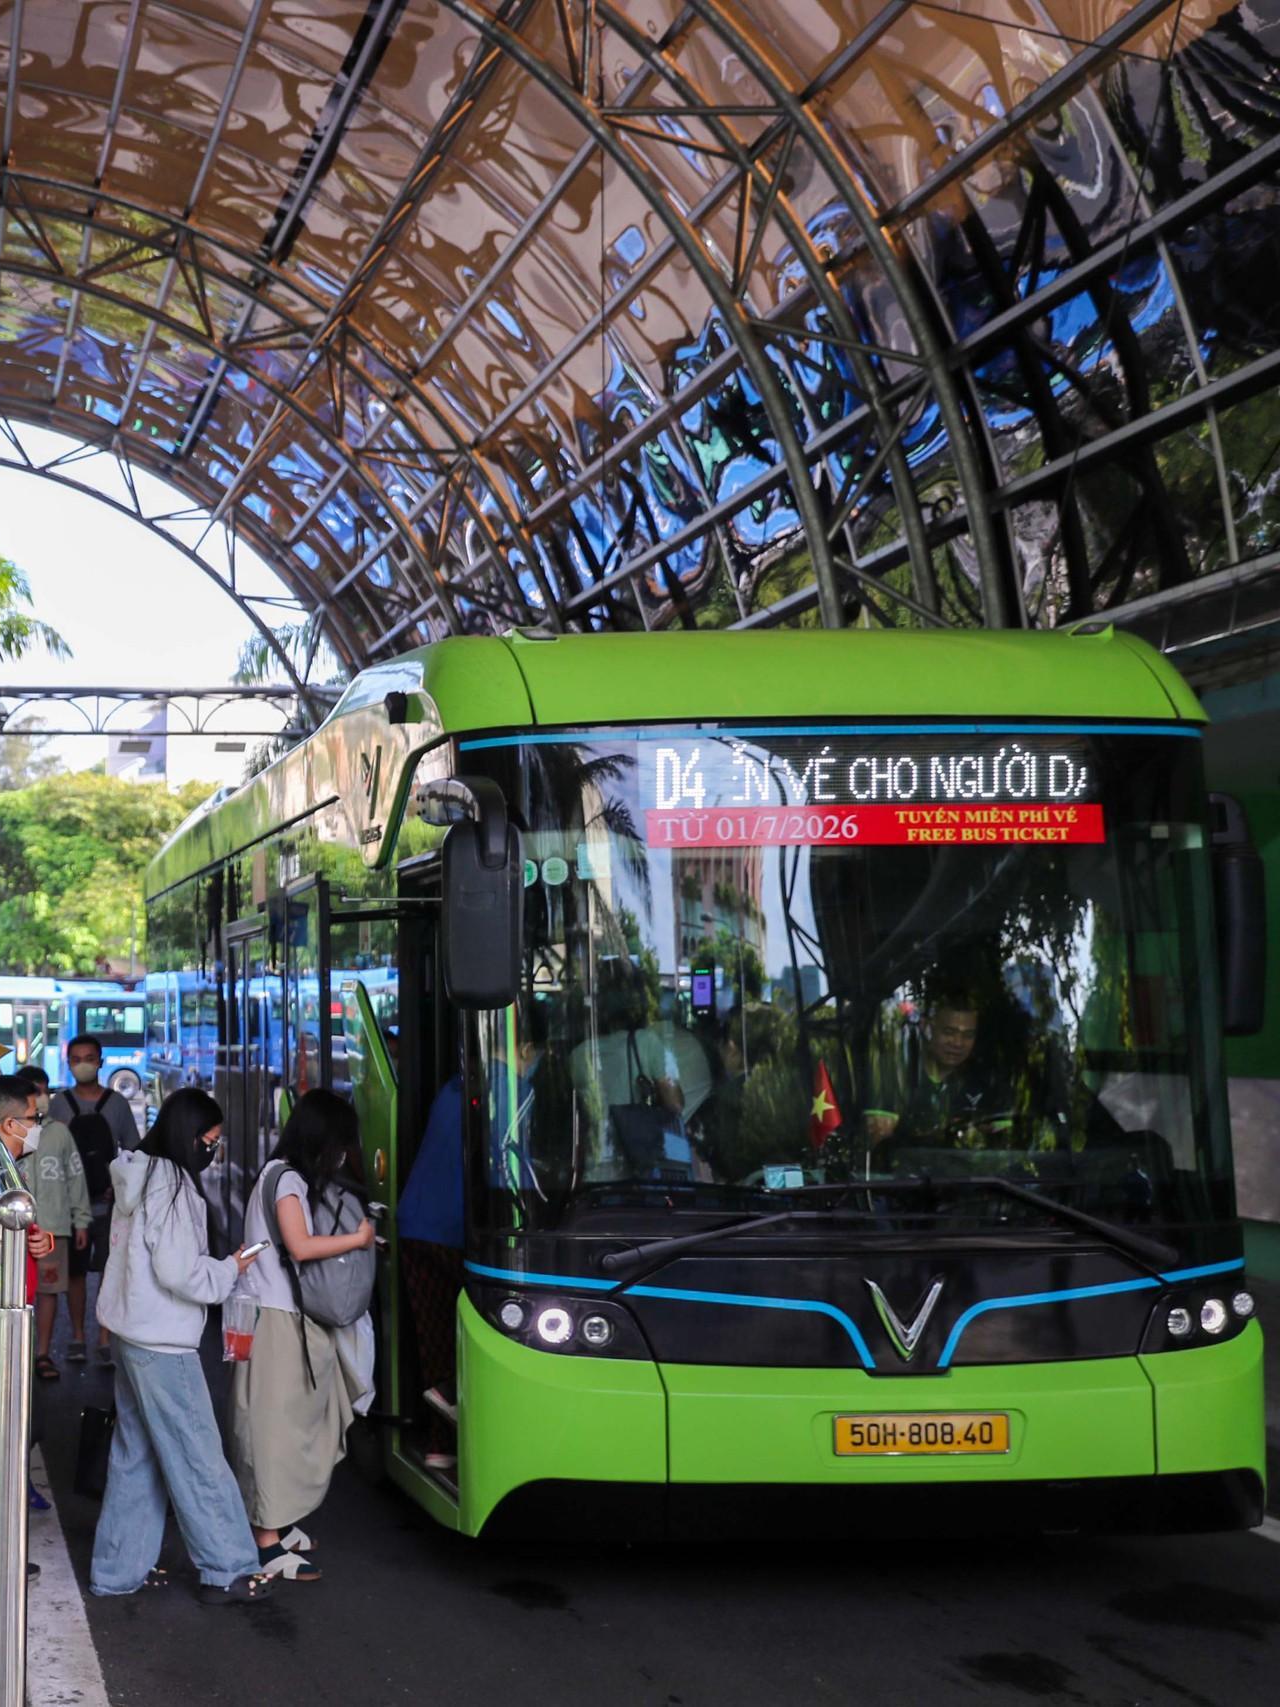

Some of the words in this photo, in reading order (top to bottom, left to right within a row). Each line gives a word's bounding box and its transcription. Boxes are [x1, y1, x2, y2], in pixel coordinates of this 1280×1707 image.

[655, 747, 706, 810] D4
[782, 745, 836, 800] VÉ
[849, 757, 918, 799] CHO
[930, 743, 1037, 799] NGƯỜI
[657, 811, 709, 842] TỪ
[716, 813, 859, 842] 01/7/2026
[907, 828, 957, 842] FREE
[961, 827, 997, 841] BUS
[1000, 826, 1070, 841] TICKET
[850, 1421, 993, 1447] 50H-808.40
